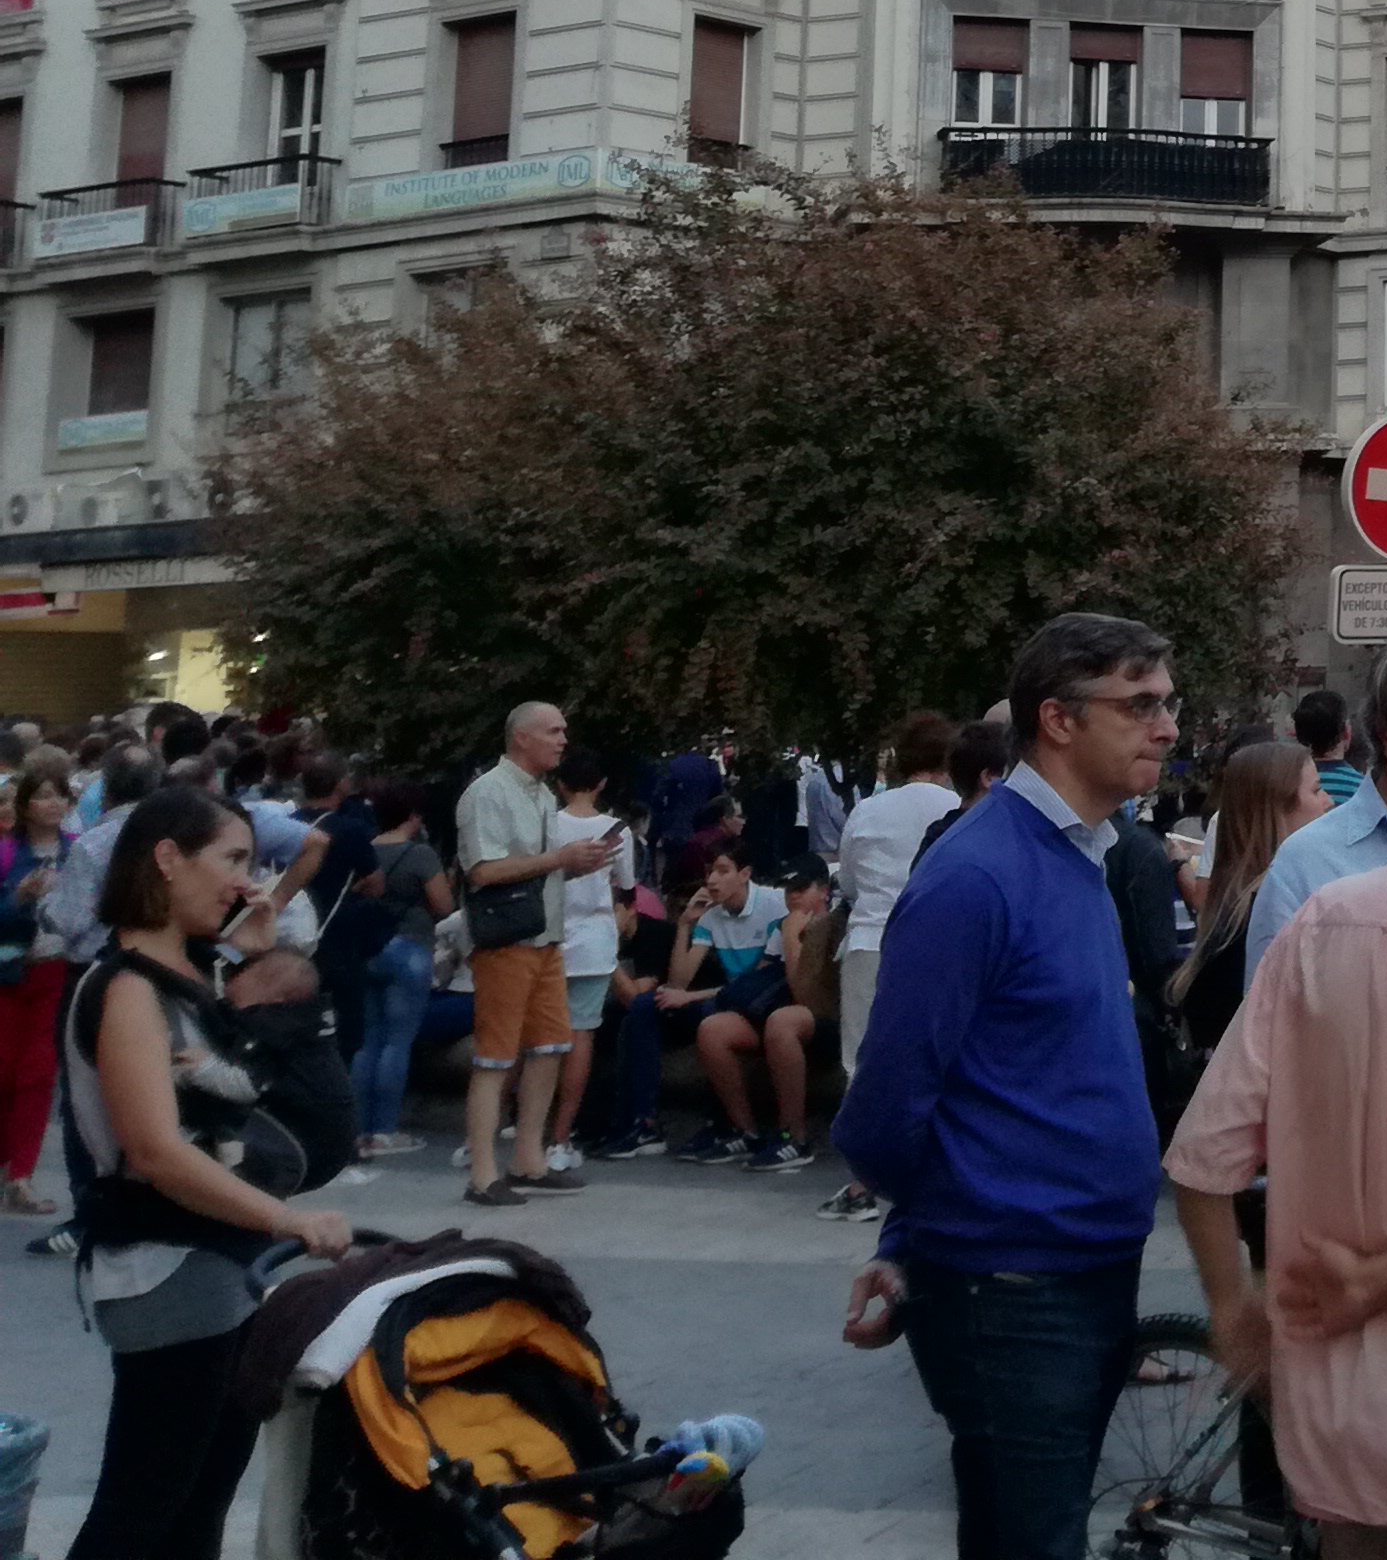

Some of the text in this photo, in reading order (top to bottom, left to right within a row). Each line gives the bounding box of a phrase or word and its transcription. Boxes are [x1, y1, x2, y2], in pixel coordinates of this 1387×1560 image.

[385, 173, 457, 197] INSTITUTE
[461, 170, 480, 184] OF
[484, 161, 550, 183] MODERN
[423, 184, 508, 209] LANGUAGES
[84, 559, 187, 589] ROSSELLI
[1354, 617, 1367, 628] DE
